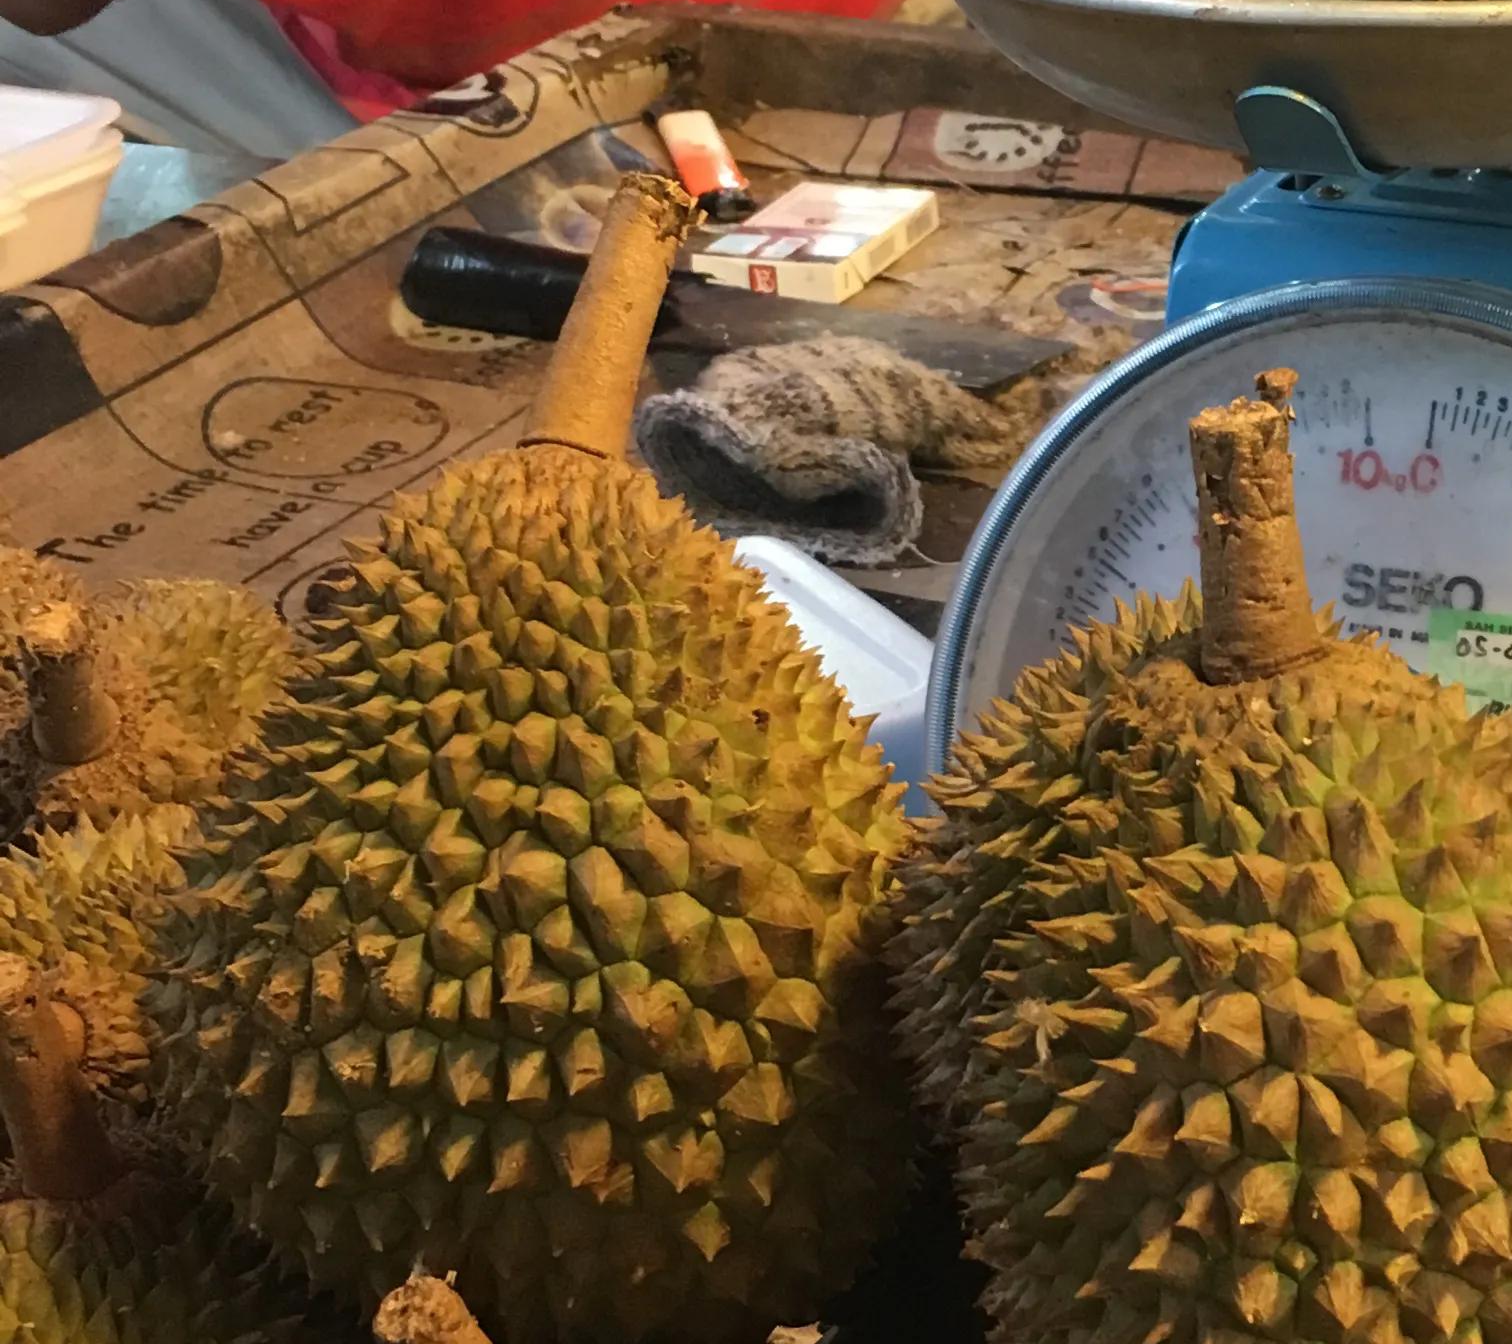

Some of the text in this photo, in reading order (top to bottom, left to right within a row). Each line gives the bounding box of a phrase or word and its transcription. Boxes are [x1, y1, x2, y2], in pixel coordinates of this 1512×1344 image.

[1456, 386, 1464, 401] 1
[1476, 390, 1488, 406] 2
[33, 518, 146, 564] The
[136, 464, 230, 515] time
[209, 500, 313, 550] have
[340, 437, 408, 475] cup
